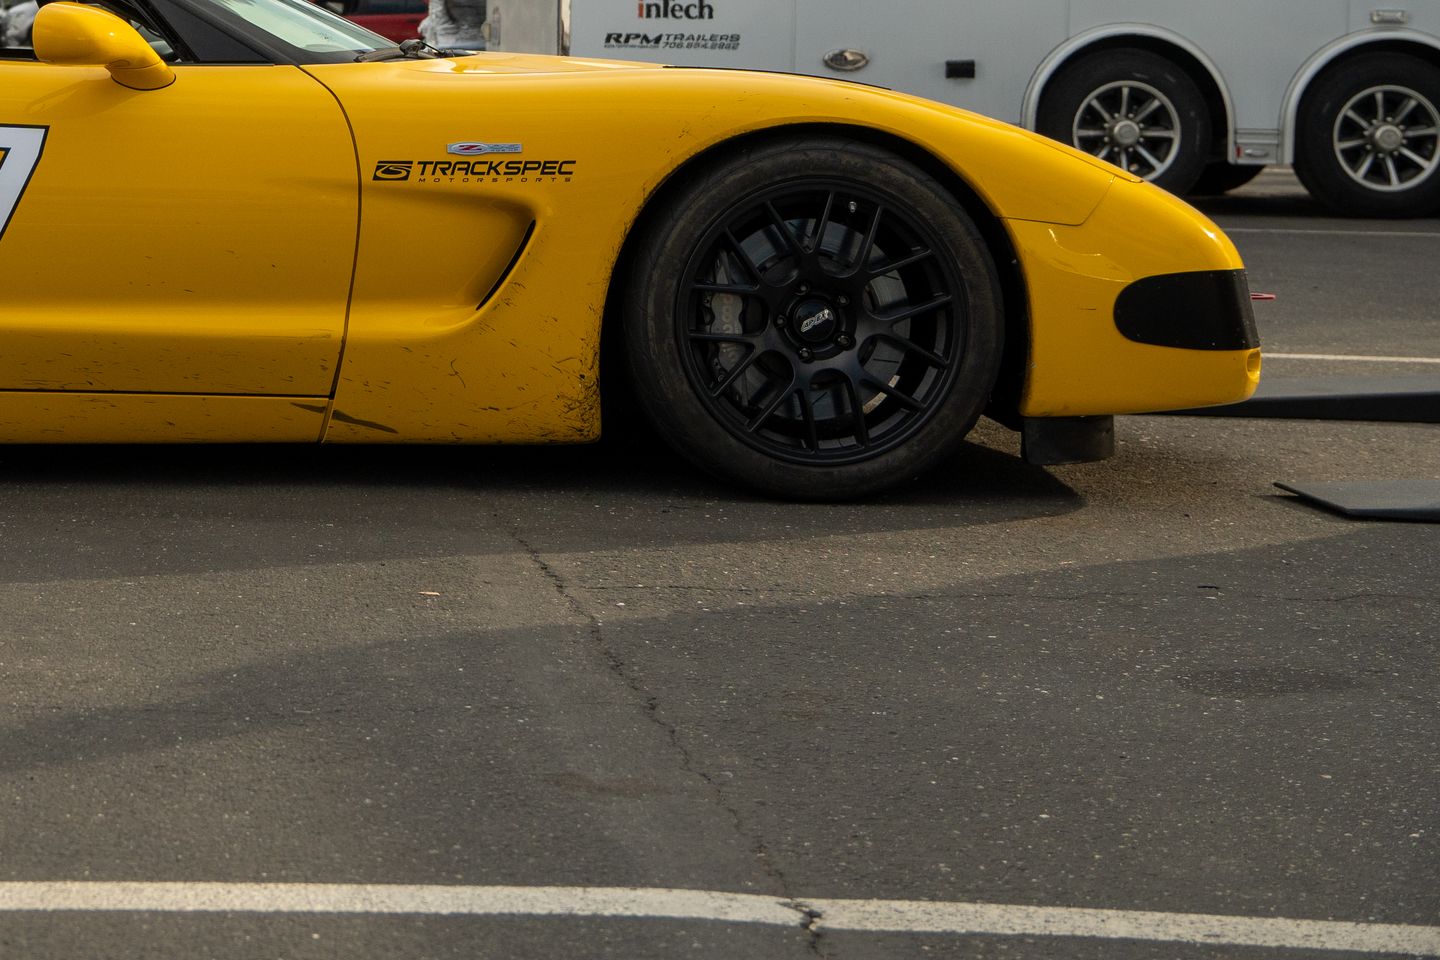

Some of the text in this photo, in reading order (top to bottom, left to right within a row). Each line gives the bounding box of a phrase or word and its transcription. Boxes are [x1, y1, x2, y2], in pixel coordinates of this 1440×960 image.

[604, 33, 741, 44] RPM TRAILERS
[417, 160, 576, 176] TRACKSPEC
